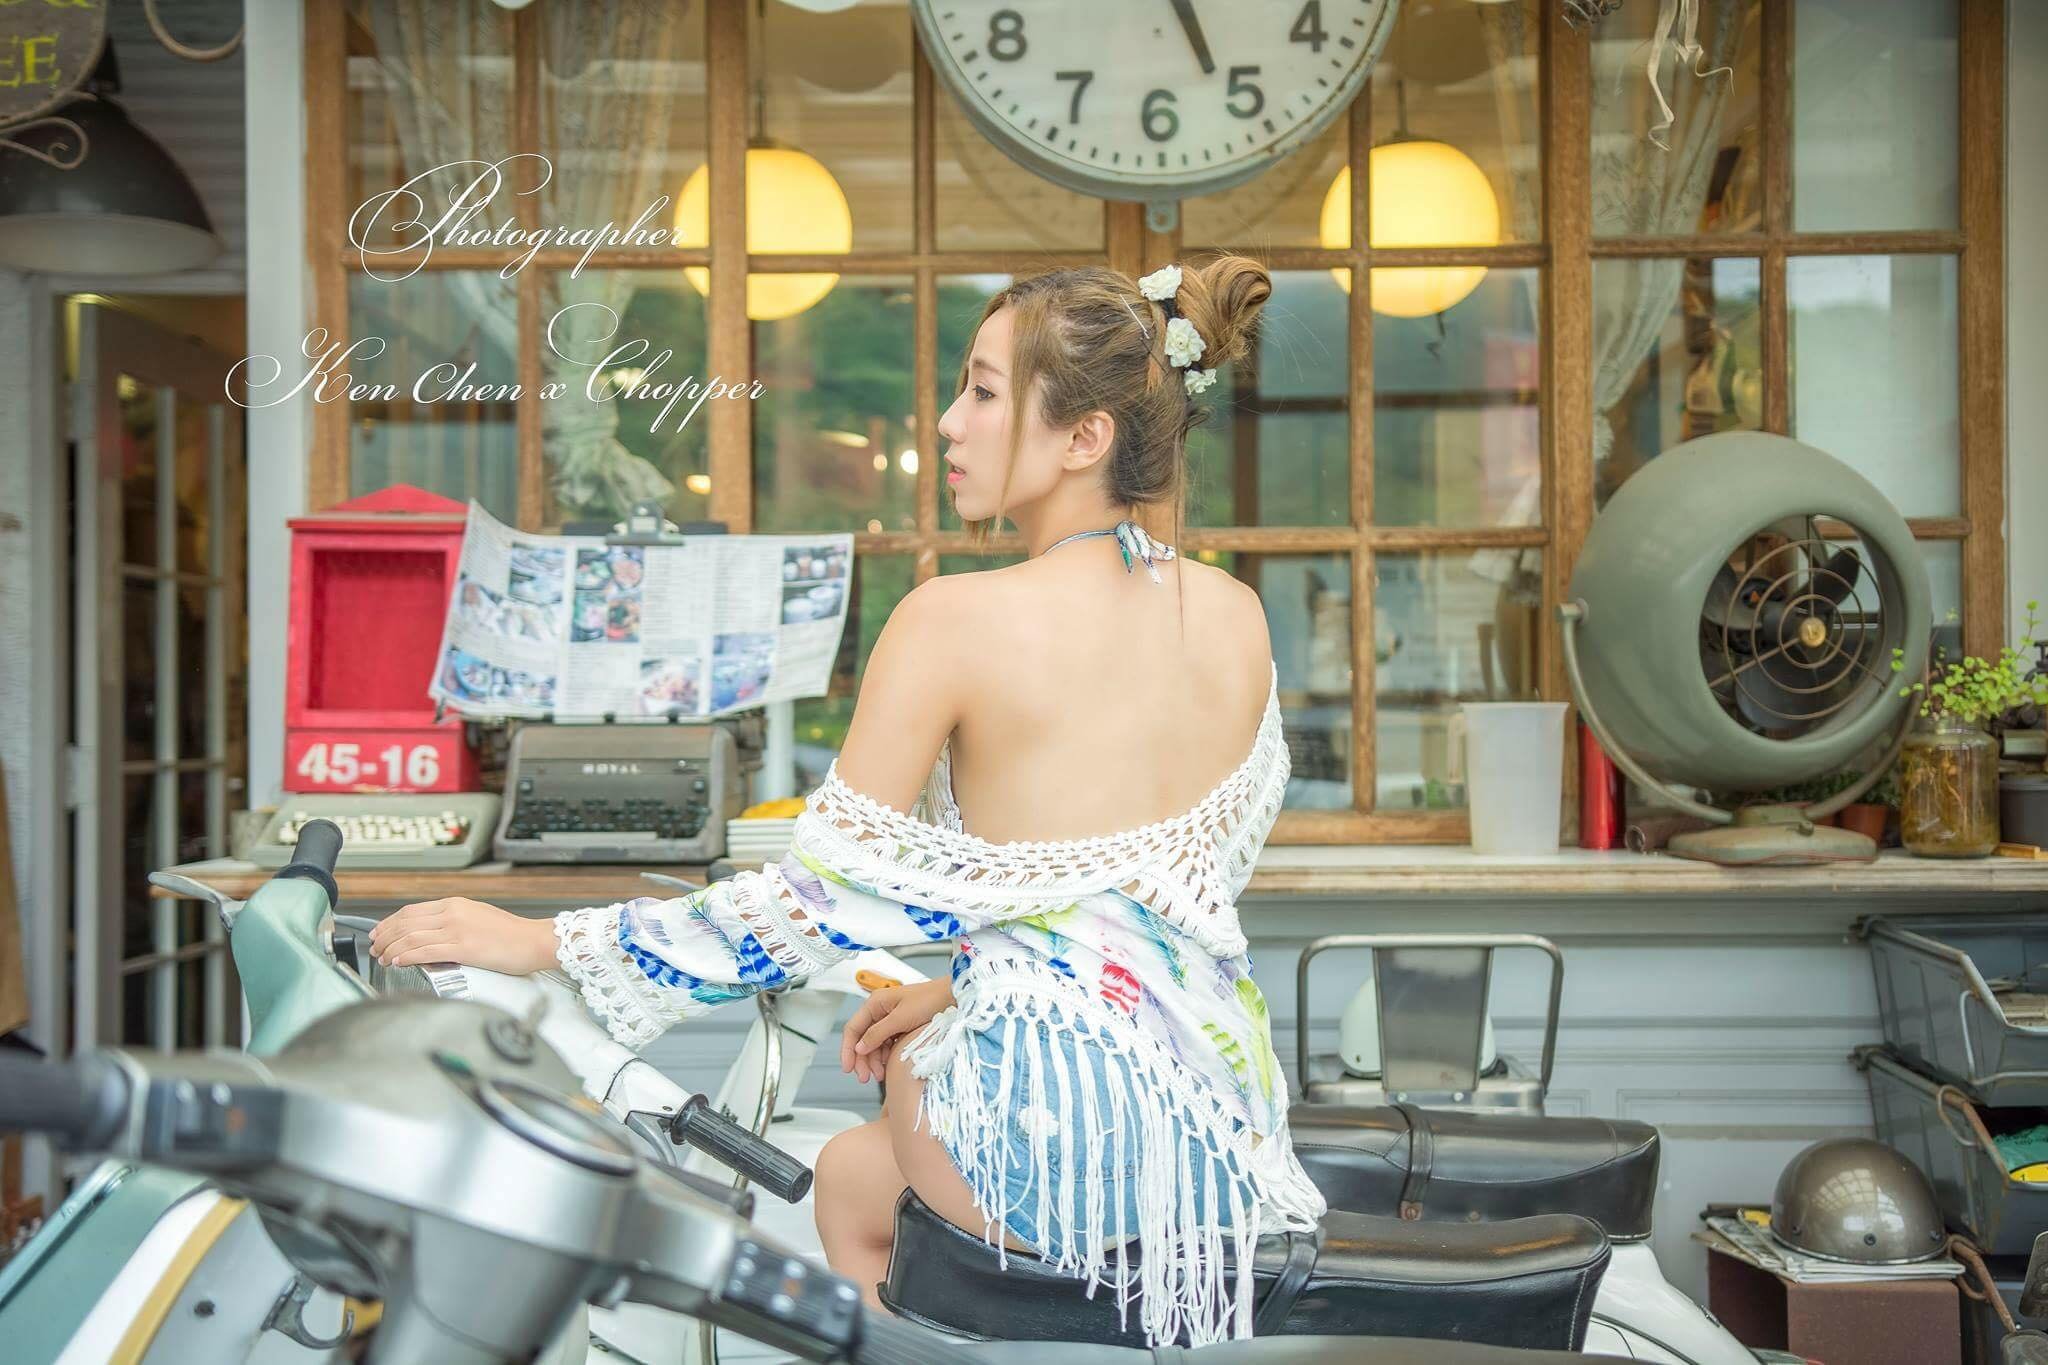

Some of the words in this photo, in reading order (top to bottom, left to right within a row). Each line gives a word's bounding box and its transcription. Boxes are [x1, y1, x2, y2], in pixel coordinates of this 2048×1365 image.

[987, 9, 1029, 62] 8
[1288, 0, 1329, 53] 4
[1055, 71, 1095, 124] 7
[1141, 89, 1179, 142] 6
[1225, 65, 1265, 119] 5
[297, 742, 441, 788] 45-16
